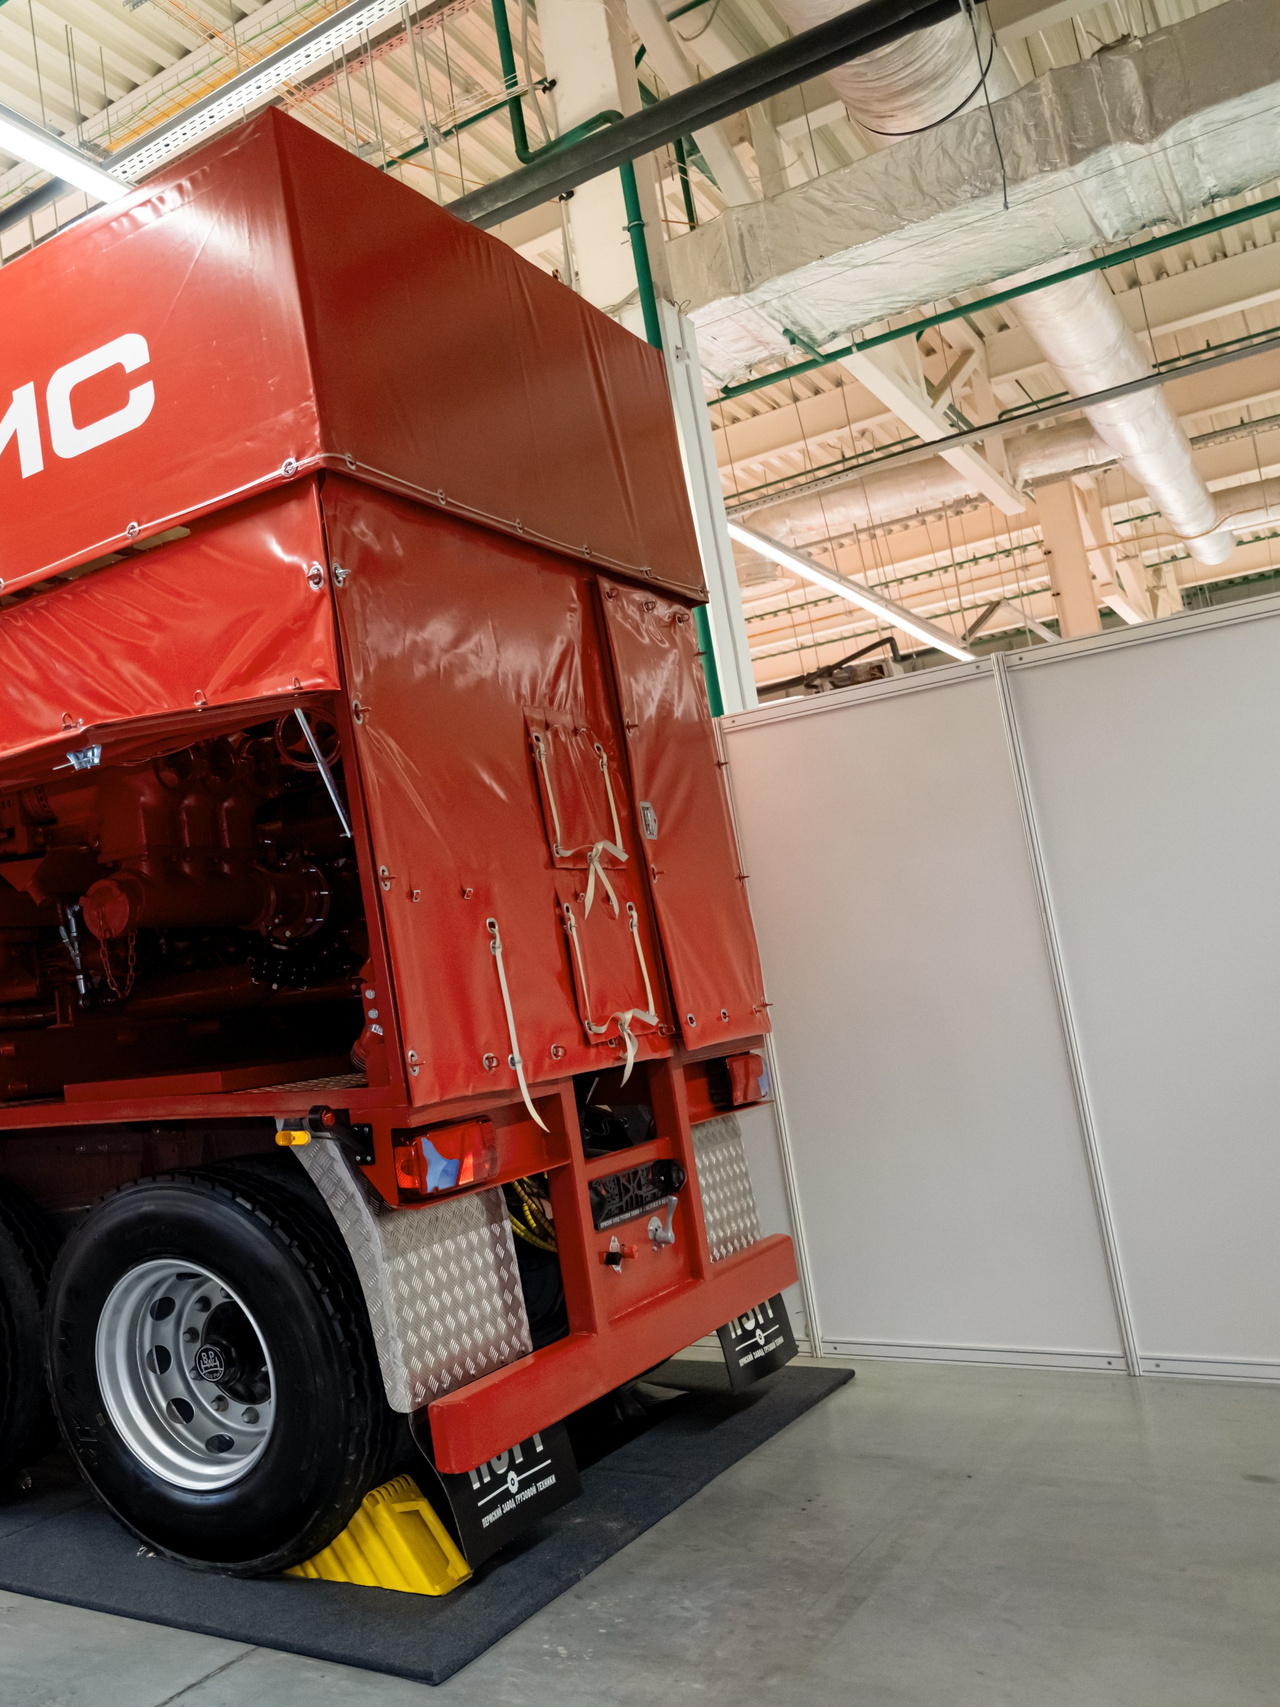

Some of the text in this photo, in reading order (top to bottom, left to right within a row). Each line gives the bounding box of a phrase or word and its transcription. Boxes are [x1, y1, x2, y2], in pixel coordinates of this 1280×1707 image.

[481, 1474, 557, 1529] ПЕРМСКИЙ ЗАВОД ГРУЗОВОЙ ТЕХНИКИ
